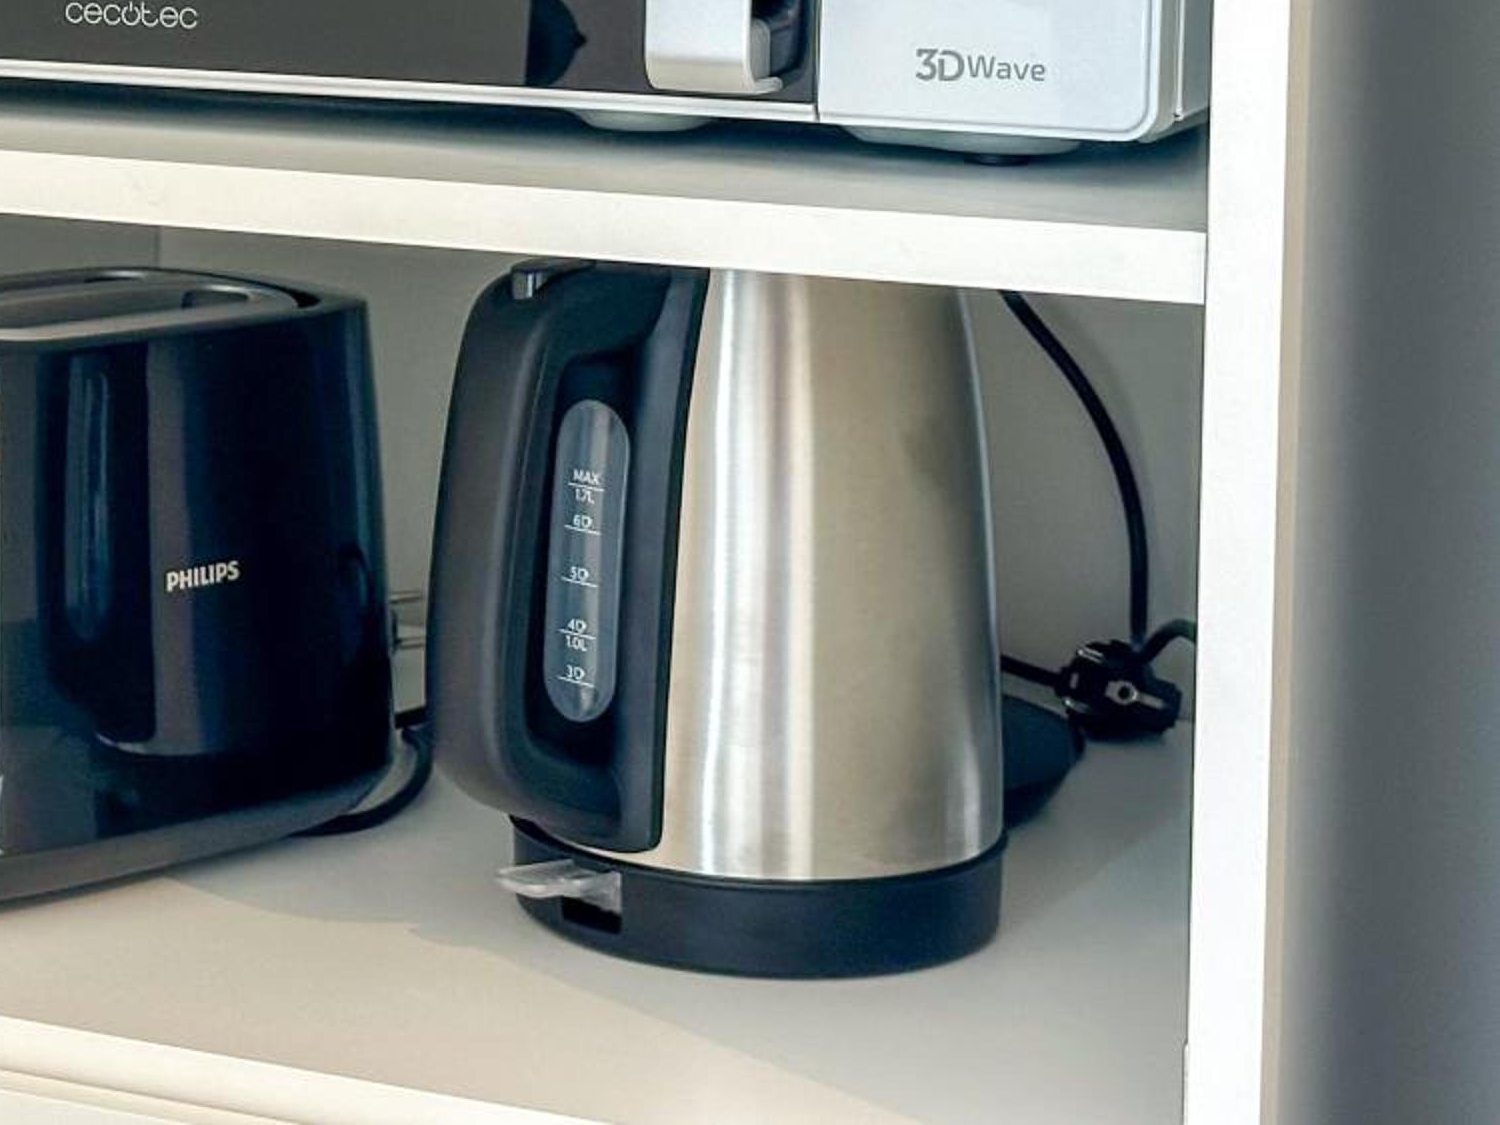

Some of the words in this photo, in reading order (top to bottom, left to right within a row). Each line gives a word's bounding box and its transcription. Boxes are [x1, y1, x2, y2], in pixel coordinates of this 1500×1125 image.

[65, 0, 198, 29] cecotec
[573, 469, 600, 485] MAX
[165, 560, 241, 592] PHILIPS
